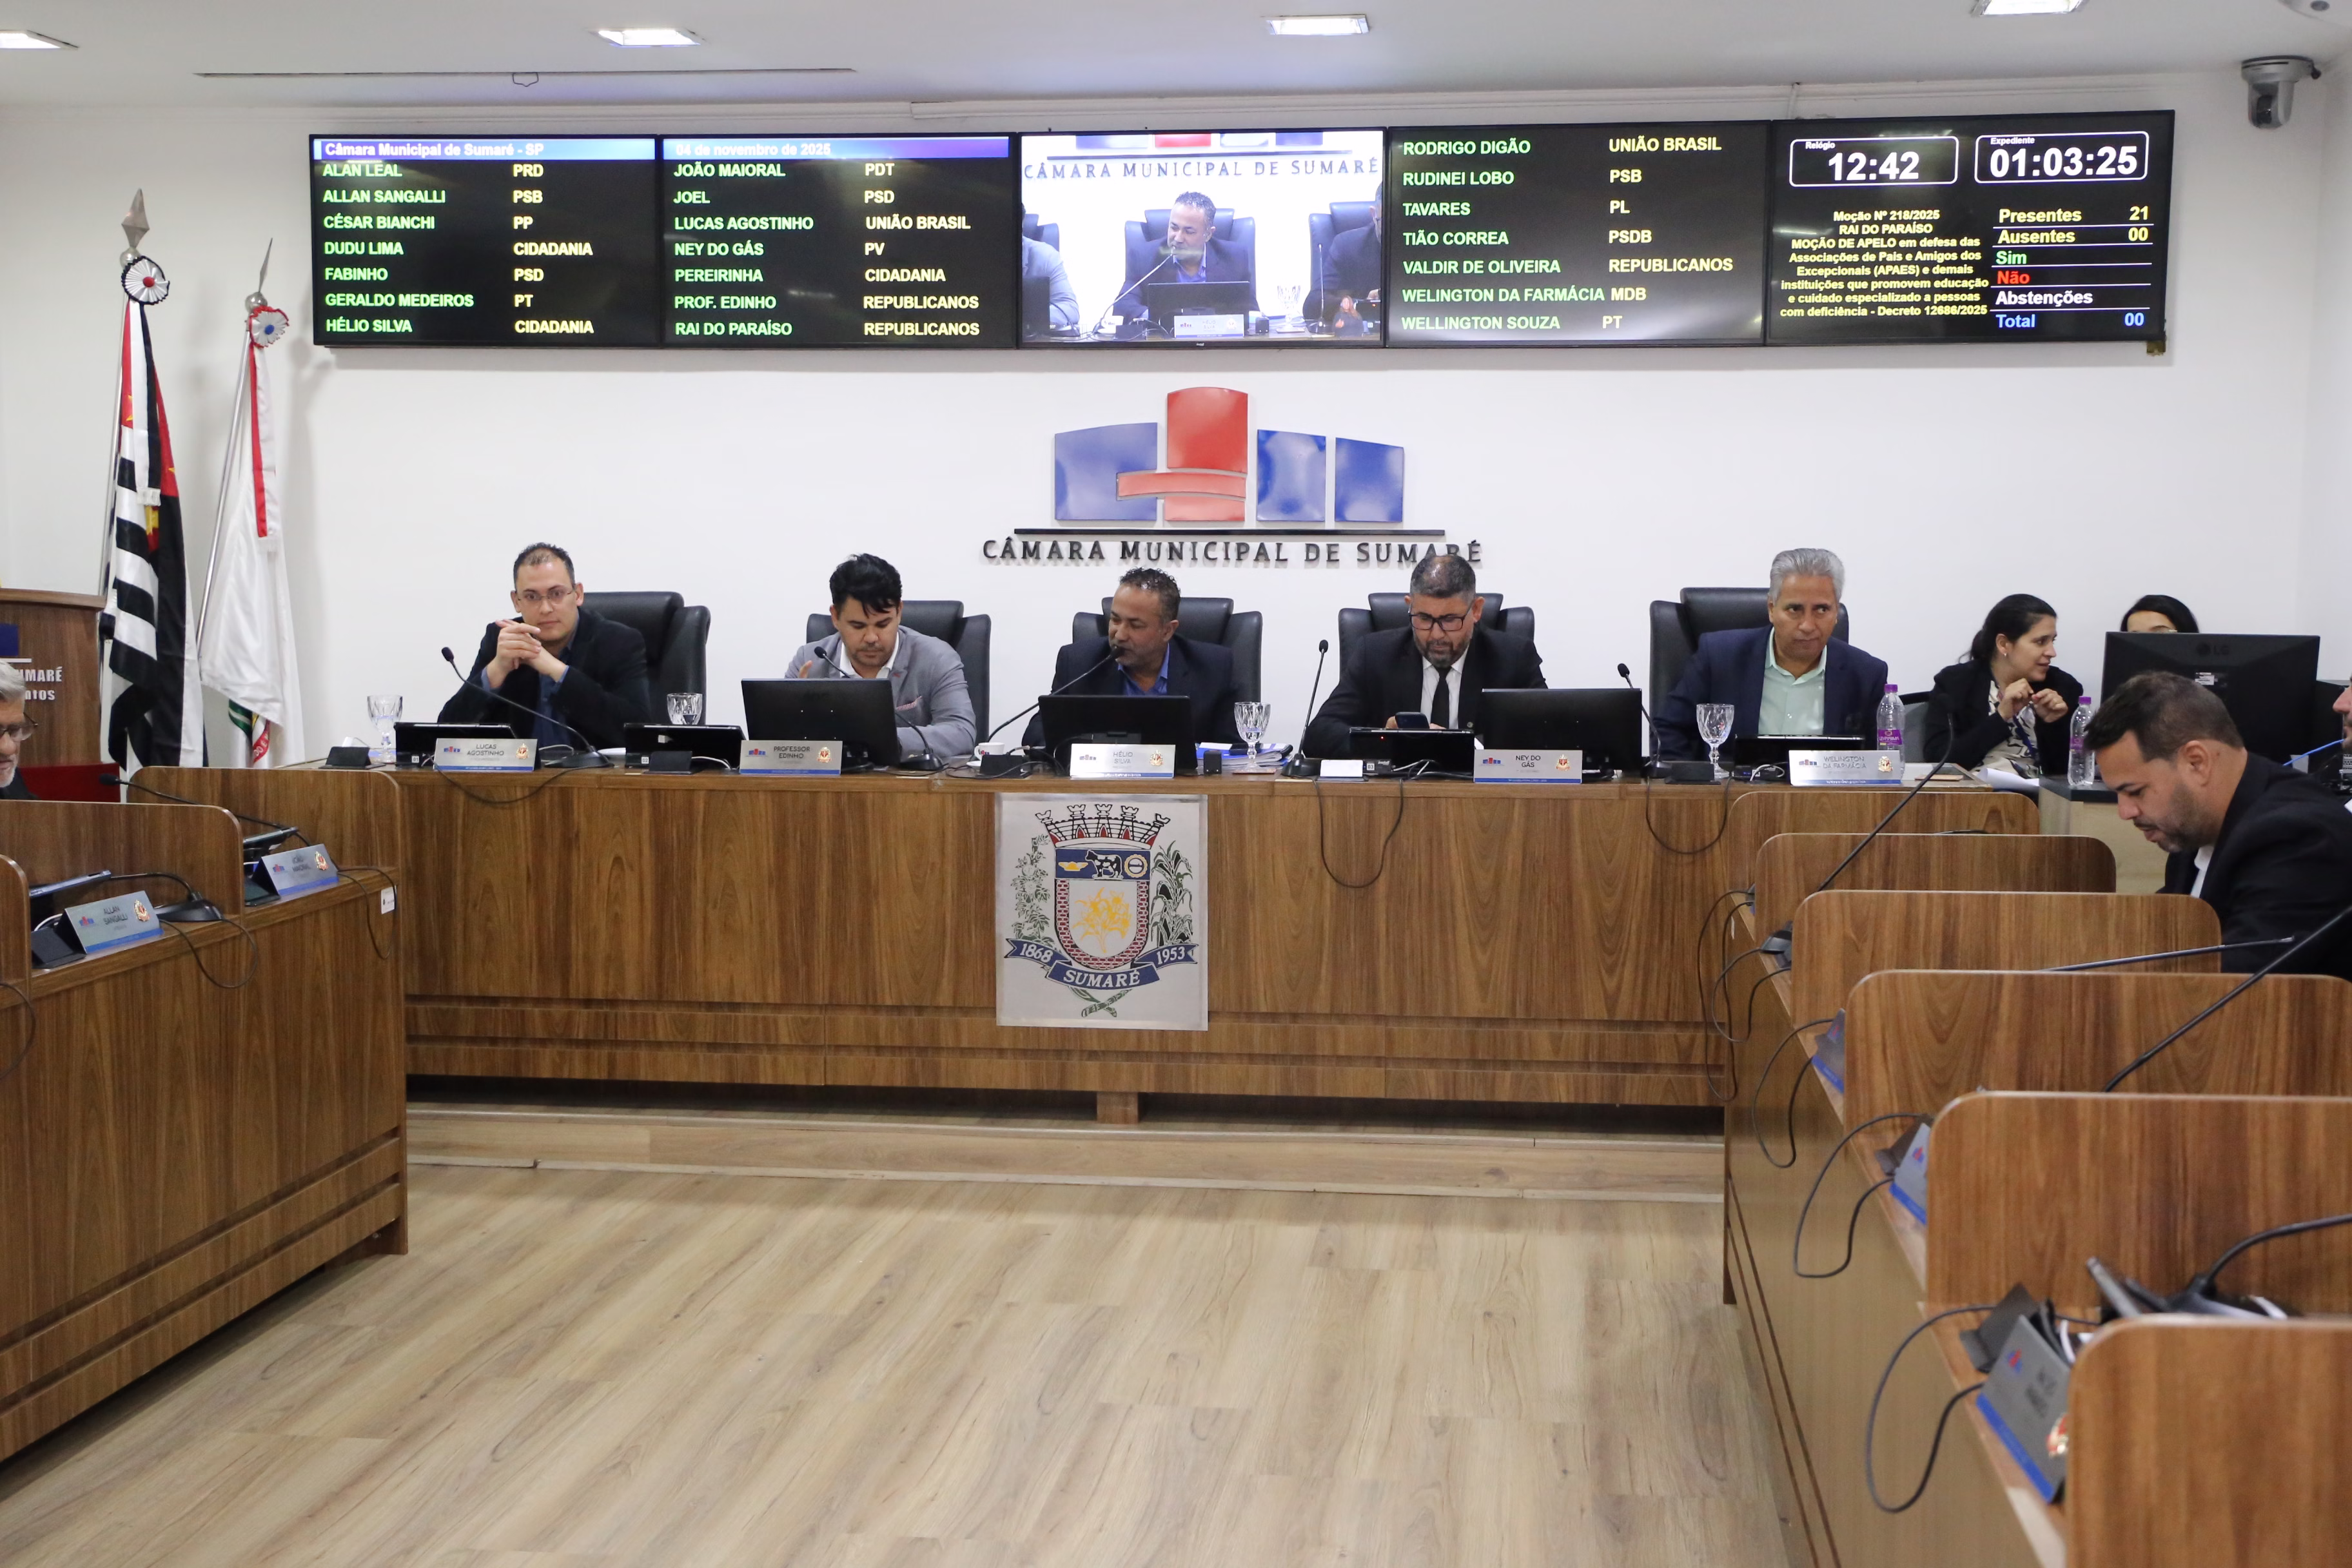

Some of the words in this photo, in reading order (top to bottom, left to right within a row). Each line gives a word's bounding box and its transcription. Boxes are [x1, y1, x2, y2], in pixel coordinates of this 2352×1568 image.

[1404, 141, 1476, 155] RODRIGO
[1481, 138, 1531, 154] DIGÃO
[1609, 135, 1659, 152] UNIÃO
[1664, 137, 1721, 151] BRASIL
[1805, 141, 1835, 150] Relógio
[1991, 136, 2035, 146] Expediente
[325, 143, 375, 156] Câmara
[378, 143, 441, 159] Municipal
[444, 143, 460, 155] de
[464, 143, 514, 155] Sumaré
[525, 144, 544, 155] SP
[695, 144, 710, 155] de
[714, 144, 778, 155] novembro
[781, 144, 797, 155] de
[801, 144, 830, 155] 2025
[1024, 162, 1110, 179] CÂMARA
[1123, 162, 1241, 177] MUNICIPAL
[1255, 162, 1278, 175] DE
[1291, 157, 1378, 174] SUMARÉ
[1829, 152, 1919, 181] 12:42
[1990, 146, 2137, 177] 01:03:25
[323, 164, 362, 177] ALAN
[365, 164, 403, 177] LEAL
[513, 164, 544, 177] PRD
[674, 161, 715, 177] JOÃO
[719, 164, 785, 177] MAIORAL
[865, 163, 894, 176] PDT
[1404, 172, 1465, 185] RUDINEI
[1470, 172, 1514, 184] LOBO
[1610, 170, 1642, 182] PSB
[323, 190, 370, 202] ALLAN
[374, 190, 446, 202] SANGALLI
[513, 190, 543, 203] PSB
[674, 191, 710, 203] JOEL
[865, 190, 894, 203] PSD
[1403, 202, 1470, 215] TAVARES
[1610, 201, 1630, 213] PL
[2130, 206, 2148, 220] 21
[324, 213, 373, 228] CÉSAR
[377, 216, 435, 229] BIANCHI
[866, 214, 912, 229] UNIÃO
[917, 216, 970, 229] BRASIL
[1834, 211, 1871, 223] Moção
[1890, 210, 1940, 220] 218/2025
[1999, 208, 2081, 222] Presentes
[514, 216, 533, 229] PP
[675, 217, 724, 230] LUCAS
[727, 217, 813, 230] AGOSTINHO
[1839, 225, 1859, 235] RAI
[1862, 224, 1879, 234] DO
[1882, 221, 1933, 234] PARAÍSO
[1403, 230, 1438, 245] TIÃO
[1443, 231, 1509, 245] CORREA
[1609, 230, 1652, 243] PSDB
[1998, 230, 2075, 244] Ausentes
[2128, 228, 2148, 241] 00
[325, 242, 365, 254] DUDU
[369, 242, 404, 255] LIMA
[514, 242, 593, 255] CIDADANIA
[675, 243, 704, 255] NEY
[707, 243, 729, 255] DO
[732, 240, 763, 255] GÁS
[865, 242, 885, 255] PV
[1792, 237, 1836, 250] MOÇÃO
[1838, 239, 1854, 248] DE
[1857, 238, 1896, 248] APELO
[1919, 237, 1957, 247] defesa
[1959, 237, 1980, 246] das
[1789, 253, 1859, 264] Associações
[1862, 252, 1876, 261] de
[1879, 251, 1903, 261] Pais
[1915, 251, 1957, 263] Amigos
[1961, 251, 1981, 260] dos
[1996, 251, 2026, 264] Sim
[1404, 261, 1458, 273] VALDIR
[1464, 260, 1484, 273] DE
[1488, 260, 1560, 273] OLIVEIRA
[1609, 258, 1732, 272] REPUBLICANOS
[1797, 266, 1871, 278] Excepcionais
[1874, 265, 1919, 277] (APAES)
[1932, 264, 1974, 274] demais
[325, 268, 387, 280] FABINHO
[514, 268, 544, 281] PSD
[675, 270, 763, 282] PEREIRINHA
[865, 269, 946, 282] CIDADANIA
[1997, 271, 2030, 284] Não
[1781, 280, 1844, 291] instituições
[1847, 281, 1868, 291] que
[1871, 280, 1931, 291] promovem
[1934, 278, 1989, 289] educação
[325, 293, 395, 306] GERALDO
[398, 294, 474, 307] MEDEIROS
[1402, 289, 1493, 302] WELINGTON
[1499, 289, 1520, 301] DA
[1524, 285, 1605, 301] FARMÁCIA
[1611, 288, 1646, 300] MDB
[1798, 293, 1843, 303] cuidado
[1845, 292, 1921, 305] especializado
[1934, 293, 1980, 304] pessoas
[1995, 290, 2093, 307] Abstenções
[514, 295, 533, 307] PT
[675, 296, 716, 308] PROF.
[721, 296, 776, 308] EDINHO
[864, 296, 979, 309] REPUBLICANOS
[1807, 306, 1867, 316] deficiência
[1877, 306, 1921, 315] Decreto
[1925, 305, 1987, 315] 12686/2025
[326, 317, 369, 332] HÉLIO
[373, 320, 413, 332] SILVA
[1402, 316, 1502, 330] WELLINGTON
[1507, 317, 1560, 329] SOUZA
[1602, 315, 1622, 329] PT
[1995, 314, 2035, 328] Total
[2124, 313, 2144, 326] 00
[515, 320, 594, 333] CIDADANIA
[676, 322, 700, 335] RAI
[704, 323, 725, 335] DO
[729, 320, 792, 335] PARAÍSO
[865, 323, 979, 335] REPUBLICANOS
[983, 536, 1105, 560] CÂMARA
[1120, 541, 1288, 561] MUNICIPAL
[1304, 543, 1340, 562] DE
[1020, 943, 1054, 963] 1868
[1157, 946, 1186, 965] 1953
[1063, 969, 1141, 988] SUMARÉ
